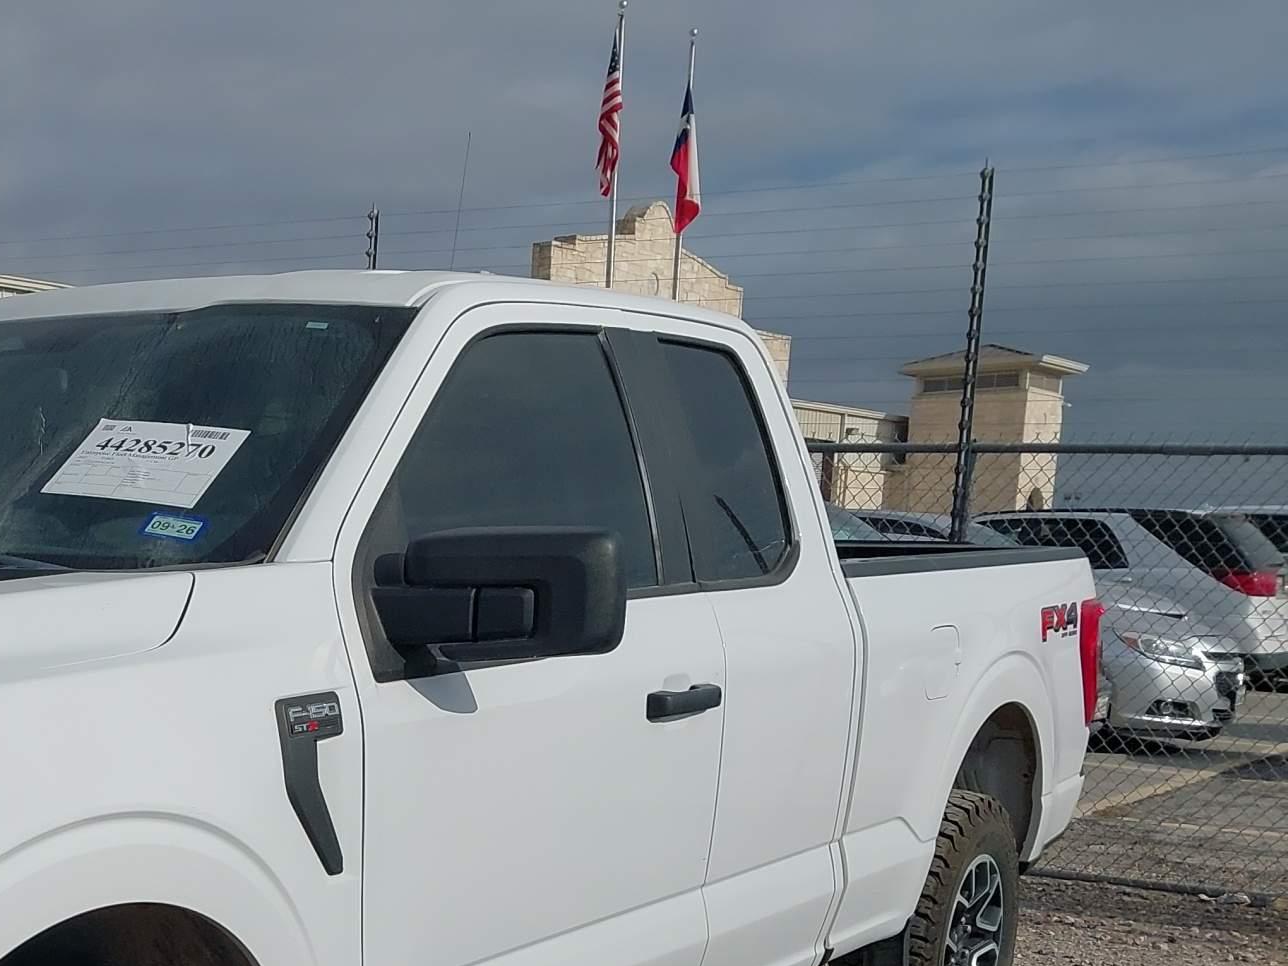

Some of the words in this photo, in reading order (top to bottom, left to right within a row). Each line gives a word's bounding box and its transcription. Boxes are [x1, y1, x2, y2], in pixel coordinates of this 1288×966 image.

[95, 437, 217, 459] 44285270
[151, 520, 169, 531] 09
[175, 524, 197, 535] 26
[1040, 601, 1078, 643] FX4
[287, 702, 340, 722] F-150
[294, 719, 320, 733] STX
